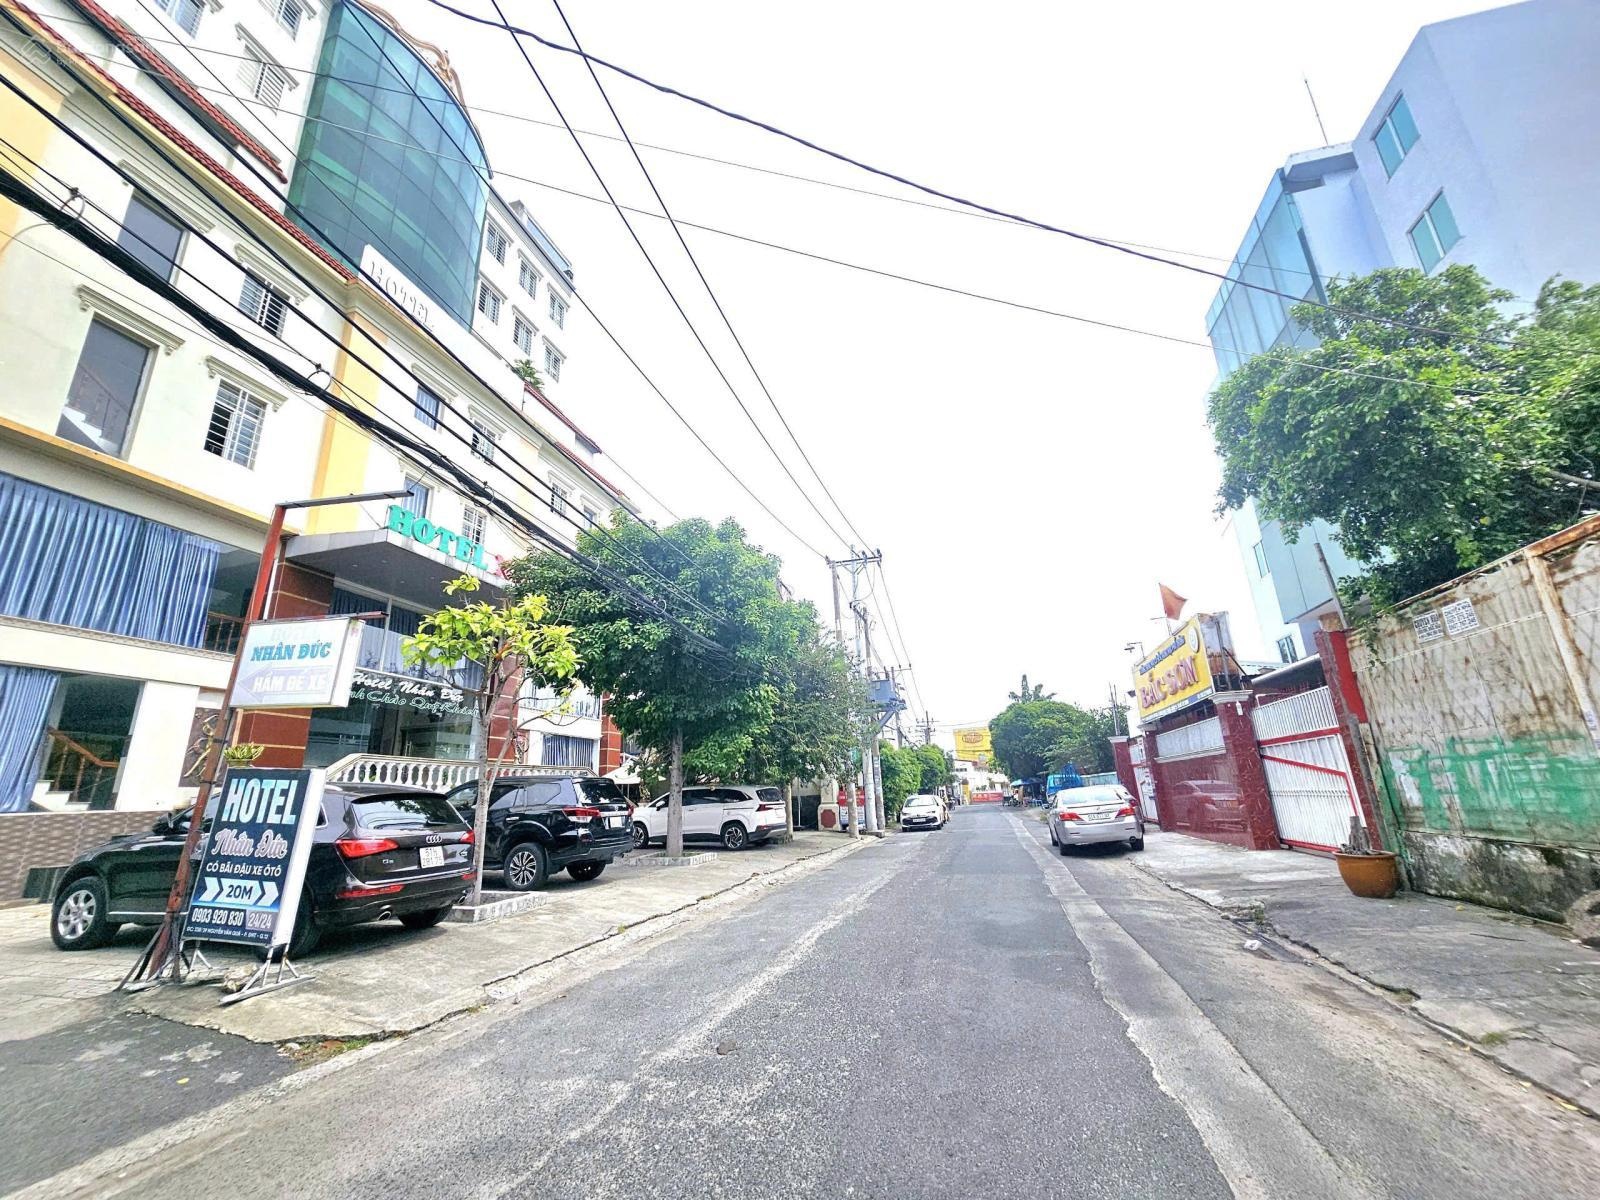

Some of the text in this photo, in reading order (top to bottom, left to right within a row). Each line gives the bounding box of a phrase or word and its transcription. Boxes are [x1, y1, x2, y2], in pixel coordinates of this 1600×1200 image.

[388, 504, 488, 571] HOTEL
[250, 640, 332, 661] NHÂN ĐỨC
[353, 672, 393, 690] Hotel
[221, 778, 299, 825] HOTEL
[211, 828, 288, 859] Nhân Đức
[206, 861, 219, 873] CÓ
[233, 864, 252, 877] ĐẬU
[252, 865, 262, 875] XE
[226, 884, 254, 900] 20M
[192, 908, 244, 926] 0903 920 830
[247, 912, 273, 929] 24/24
